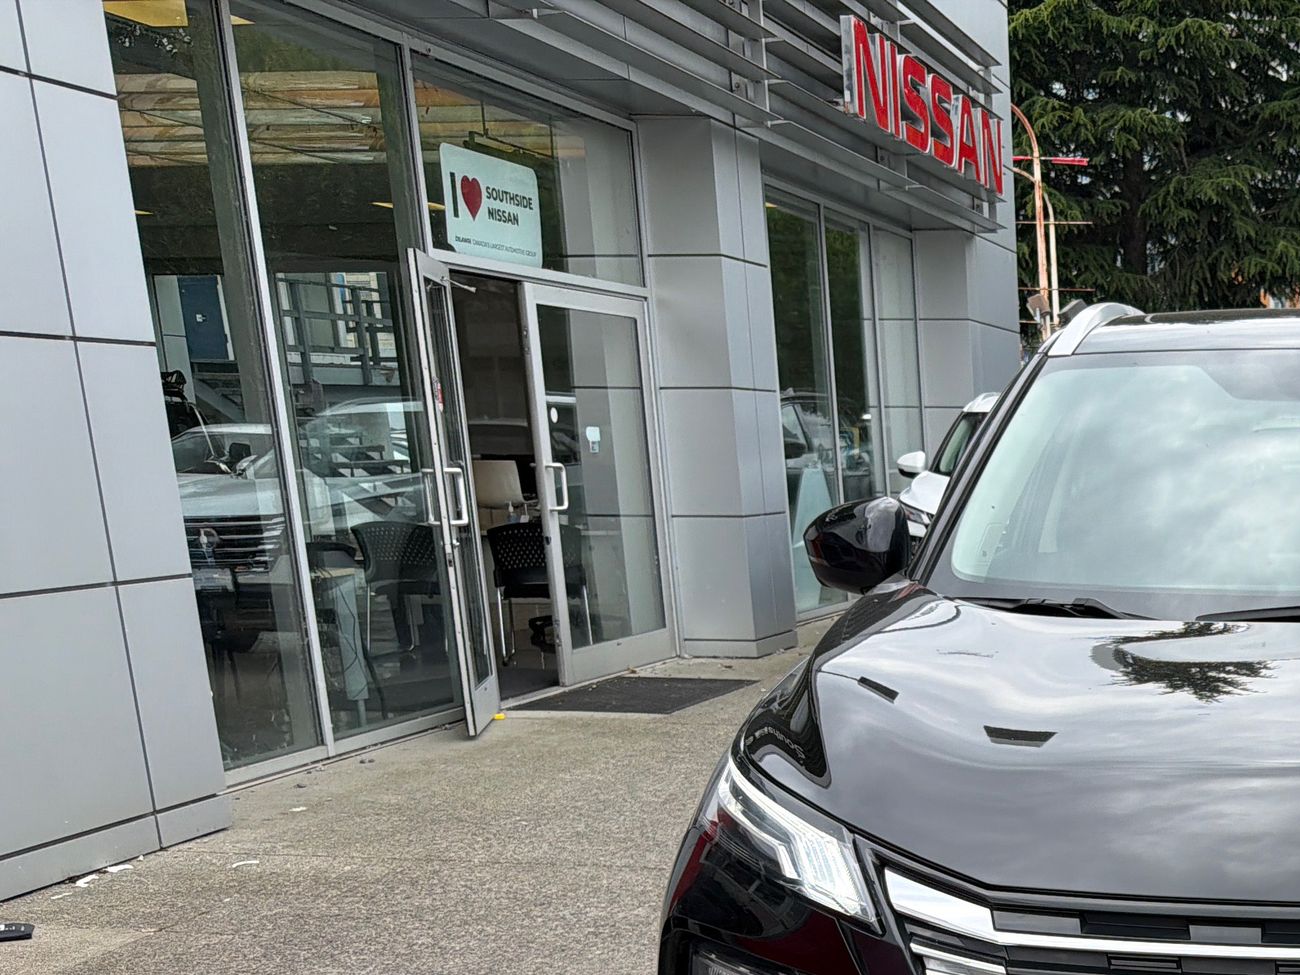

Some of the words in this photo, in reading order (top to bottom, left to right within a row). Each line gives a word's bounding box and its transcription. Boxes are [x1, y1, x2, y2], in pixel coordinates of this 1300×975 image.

[842, 15, 1003, 196] NISSAN
[449, 171, 460, 218] I
[485, 186, 534, 210] SOUTHSIDE
[487, 206, 519, 226] NISSAN
